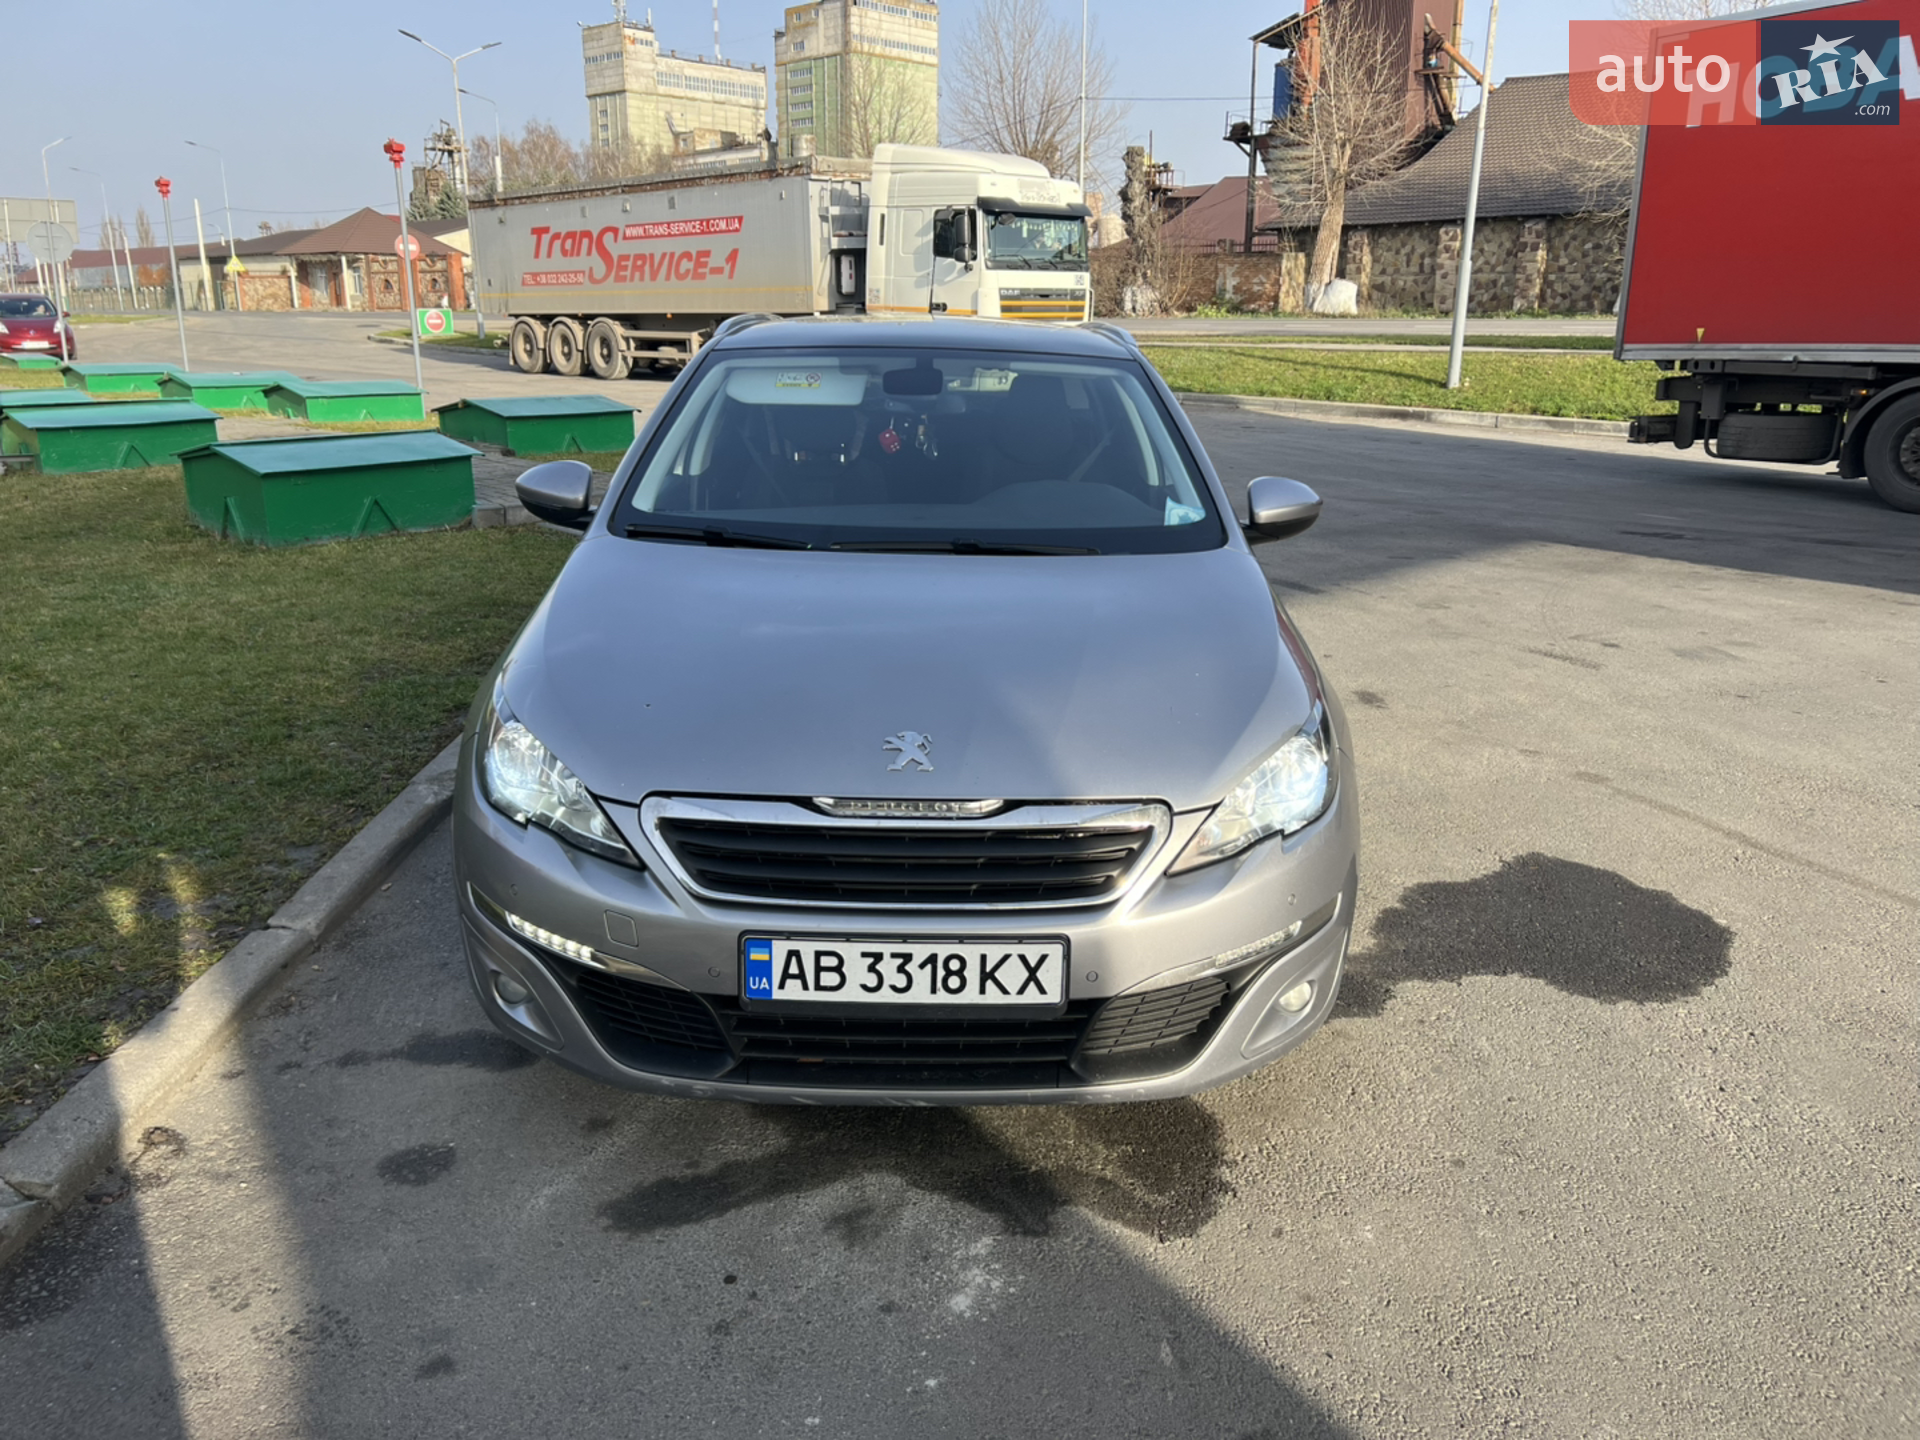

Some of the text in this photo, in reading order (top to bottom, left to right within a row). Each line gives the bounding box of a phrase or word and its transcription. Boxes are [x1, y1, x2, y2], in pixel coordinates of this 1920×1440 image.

[749, 949, 1050, 996] UA AB 3318 KX
